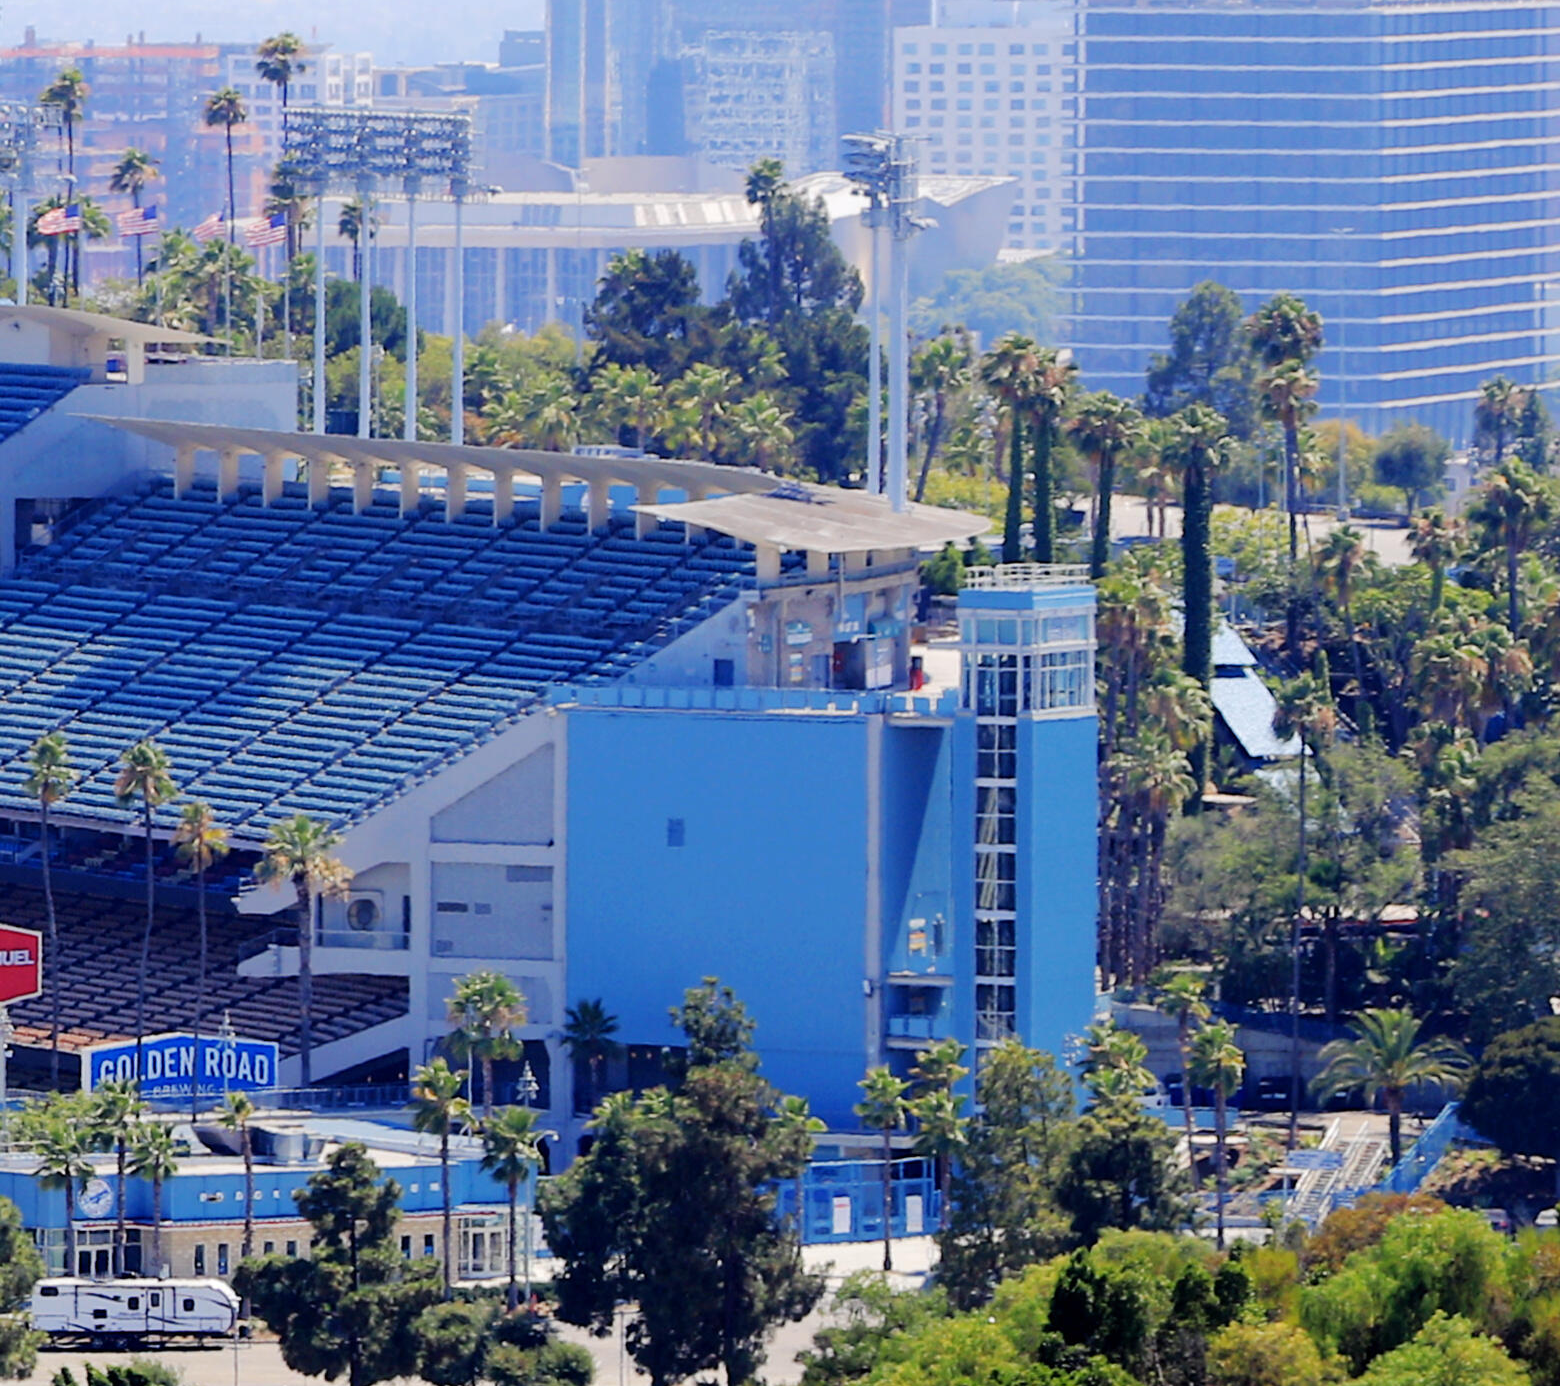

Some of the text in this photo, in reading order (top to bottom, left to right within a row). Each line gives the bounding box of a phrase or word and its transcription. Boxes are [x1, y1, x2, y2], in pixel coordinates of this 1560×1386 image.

[100, 1046, 269, 1085] GOLDEN ROAD
[153, 1084, 215, 1095] BREWNG
